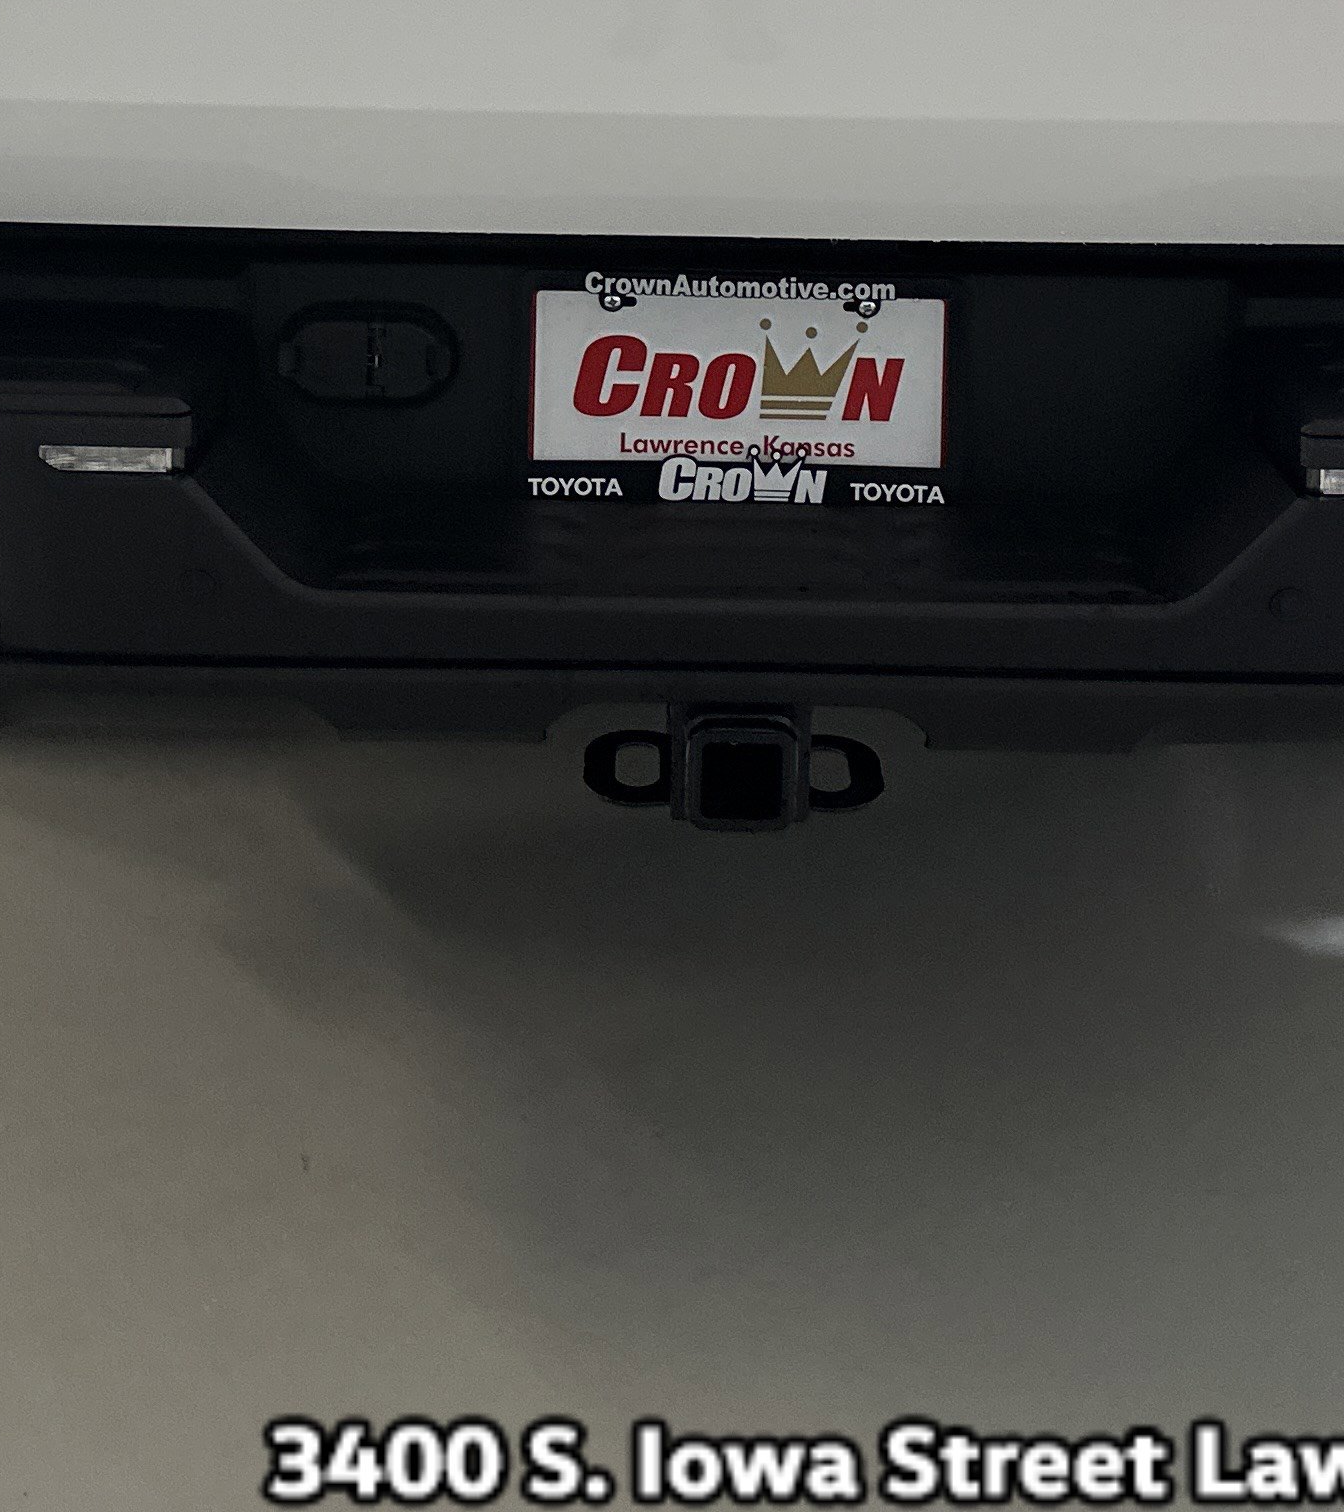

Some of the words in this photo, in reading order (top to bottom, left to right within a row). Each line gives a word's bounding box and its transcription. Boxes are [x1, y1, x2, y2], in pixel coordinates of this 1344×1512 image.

[584, 271, 896, 301] CrownAutomotive.com
[572, 318, 905, 422] CROWN
[763, 435, 856, 458] Kansas
[528, 477, 623, 497] TOYOTA
[658, 445, 828, 505] CROWN
[850, 482, 945, 504] TOYOTA
